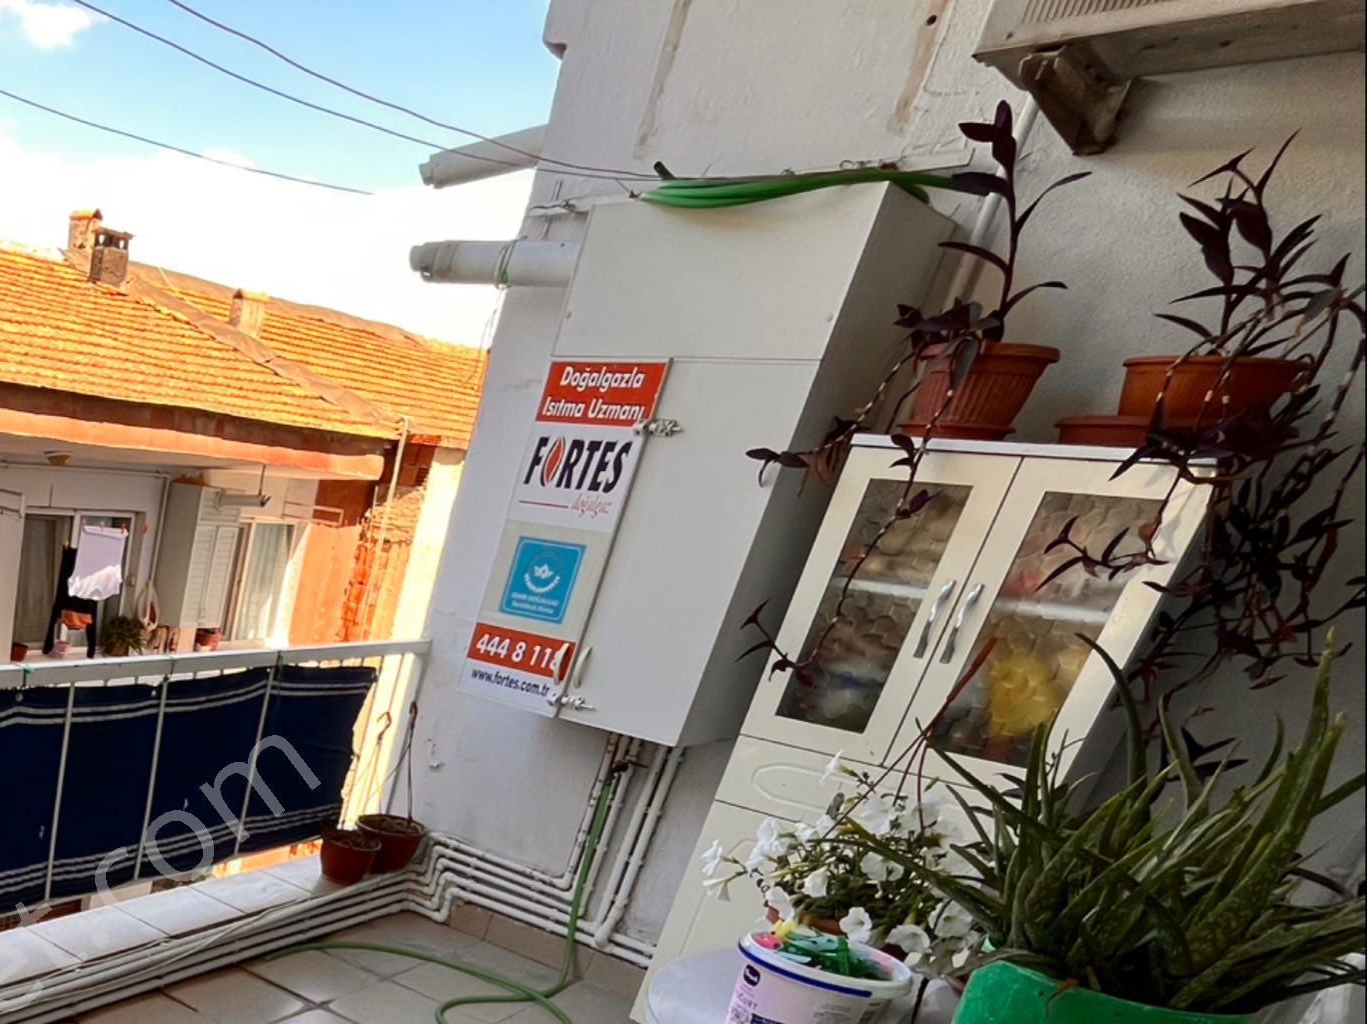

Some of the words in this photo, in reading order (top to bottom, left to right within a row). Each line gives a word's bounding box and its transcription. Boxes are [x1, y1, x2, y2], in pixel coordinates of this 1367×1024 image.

[560, 366, 646, 392] Doğalgazla
[542, 396, 585, 417] Isıtma
[588, 398, 645, 421] Uzmanı
[523, 435, 633, 493] FORTES
[476, 633, 511, 659] 444
[511, 641, 526, 662] 8
[471, 668, 551, 697] www.fortes.com.tr
